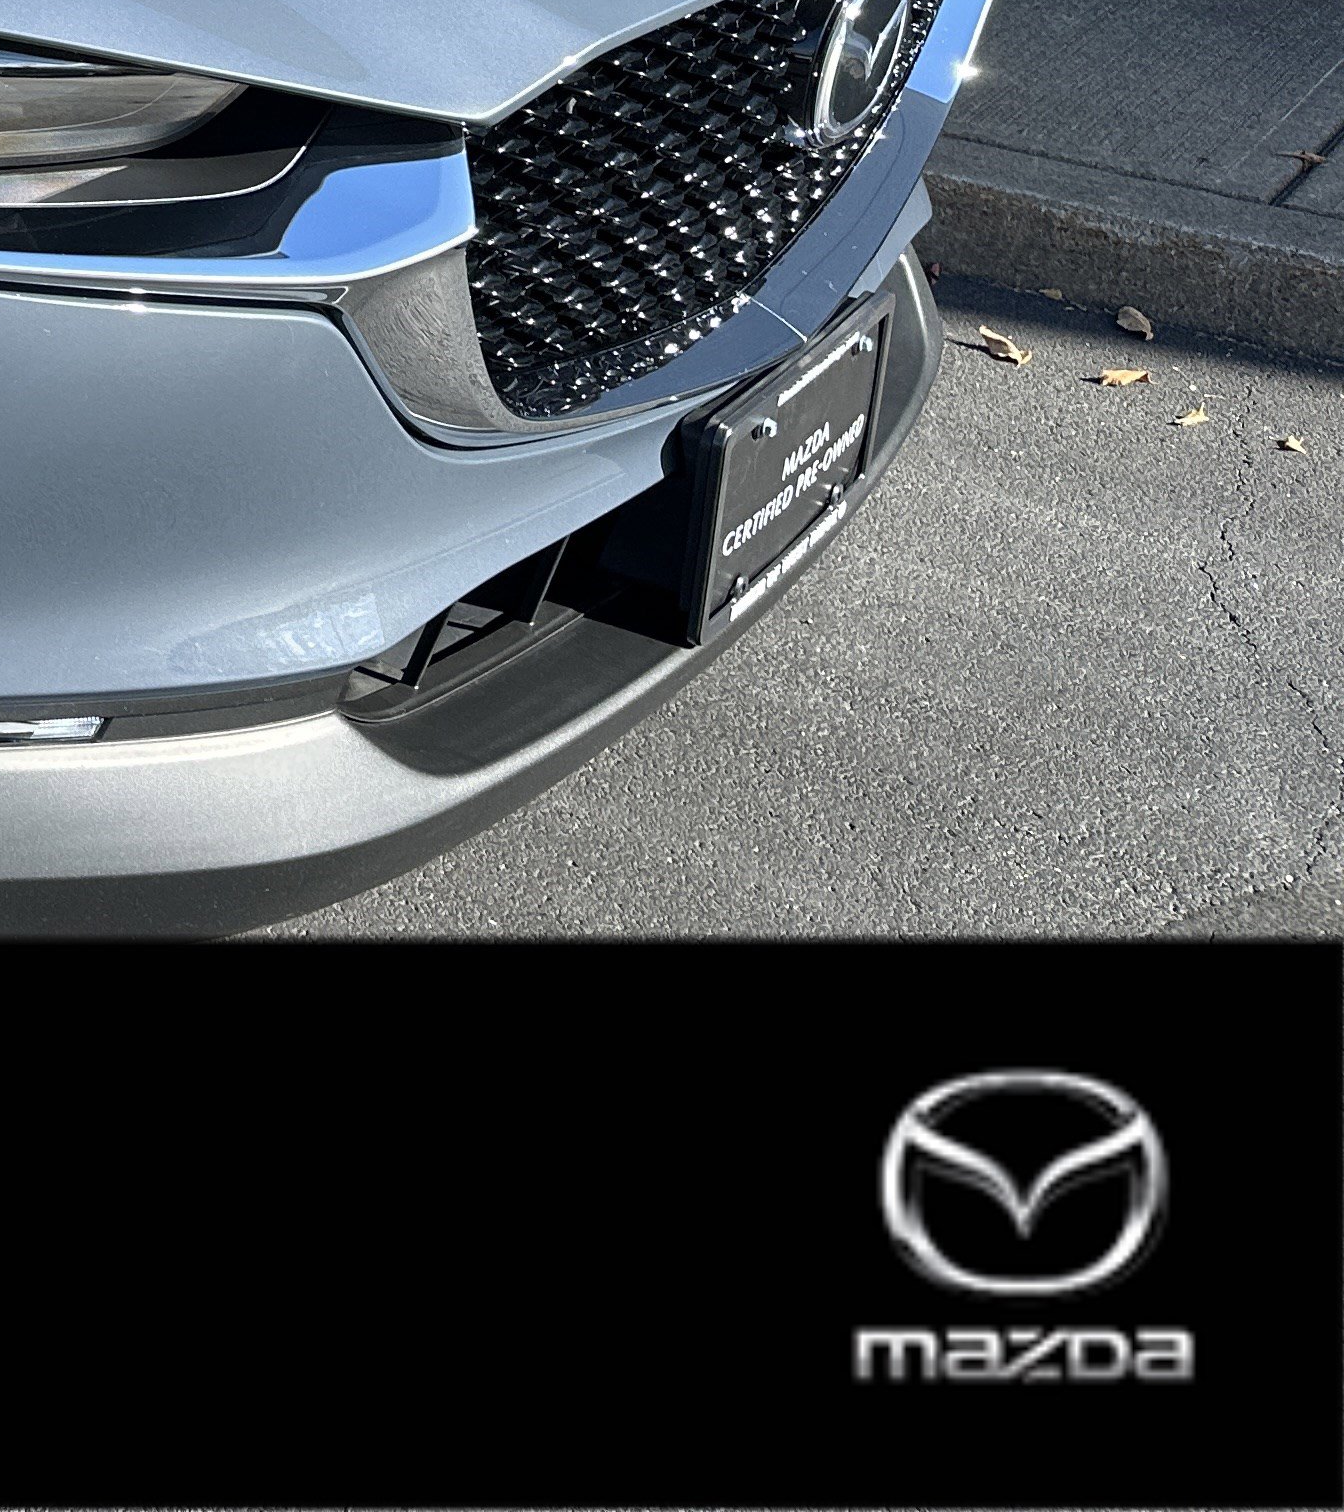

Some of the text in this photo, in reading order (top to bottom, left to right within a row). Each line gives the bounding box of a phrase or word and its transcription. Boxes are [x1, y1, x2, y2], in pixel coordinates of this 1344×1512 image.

[722, 413, 865, 557] CERTIFIED PRE-OWNED
[781, 421, 830, 481] MAZDA
